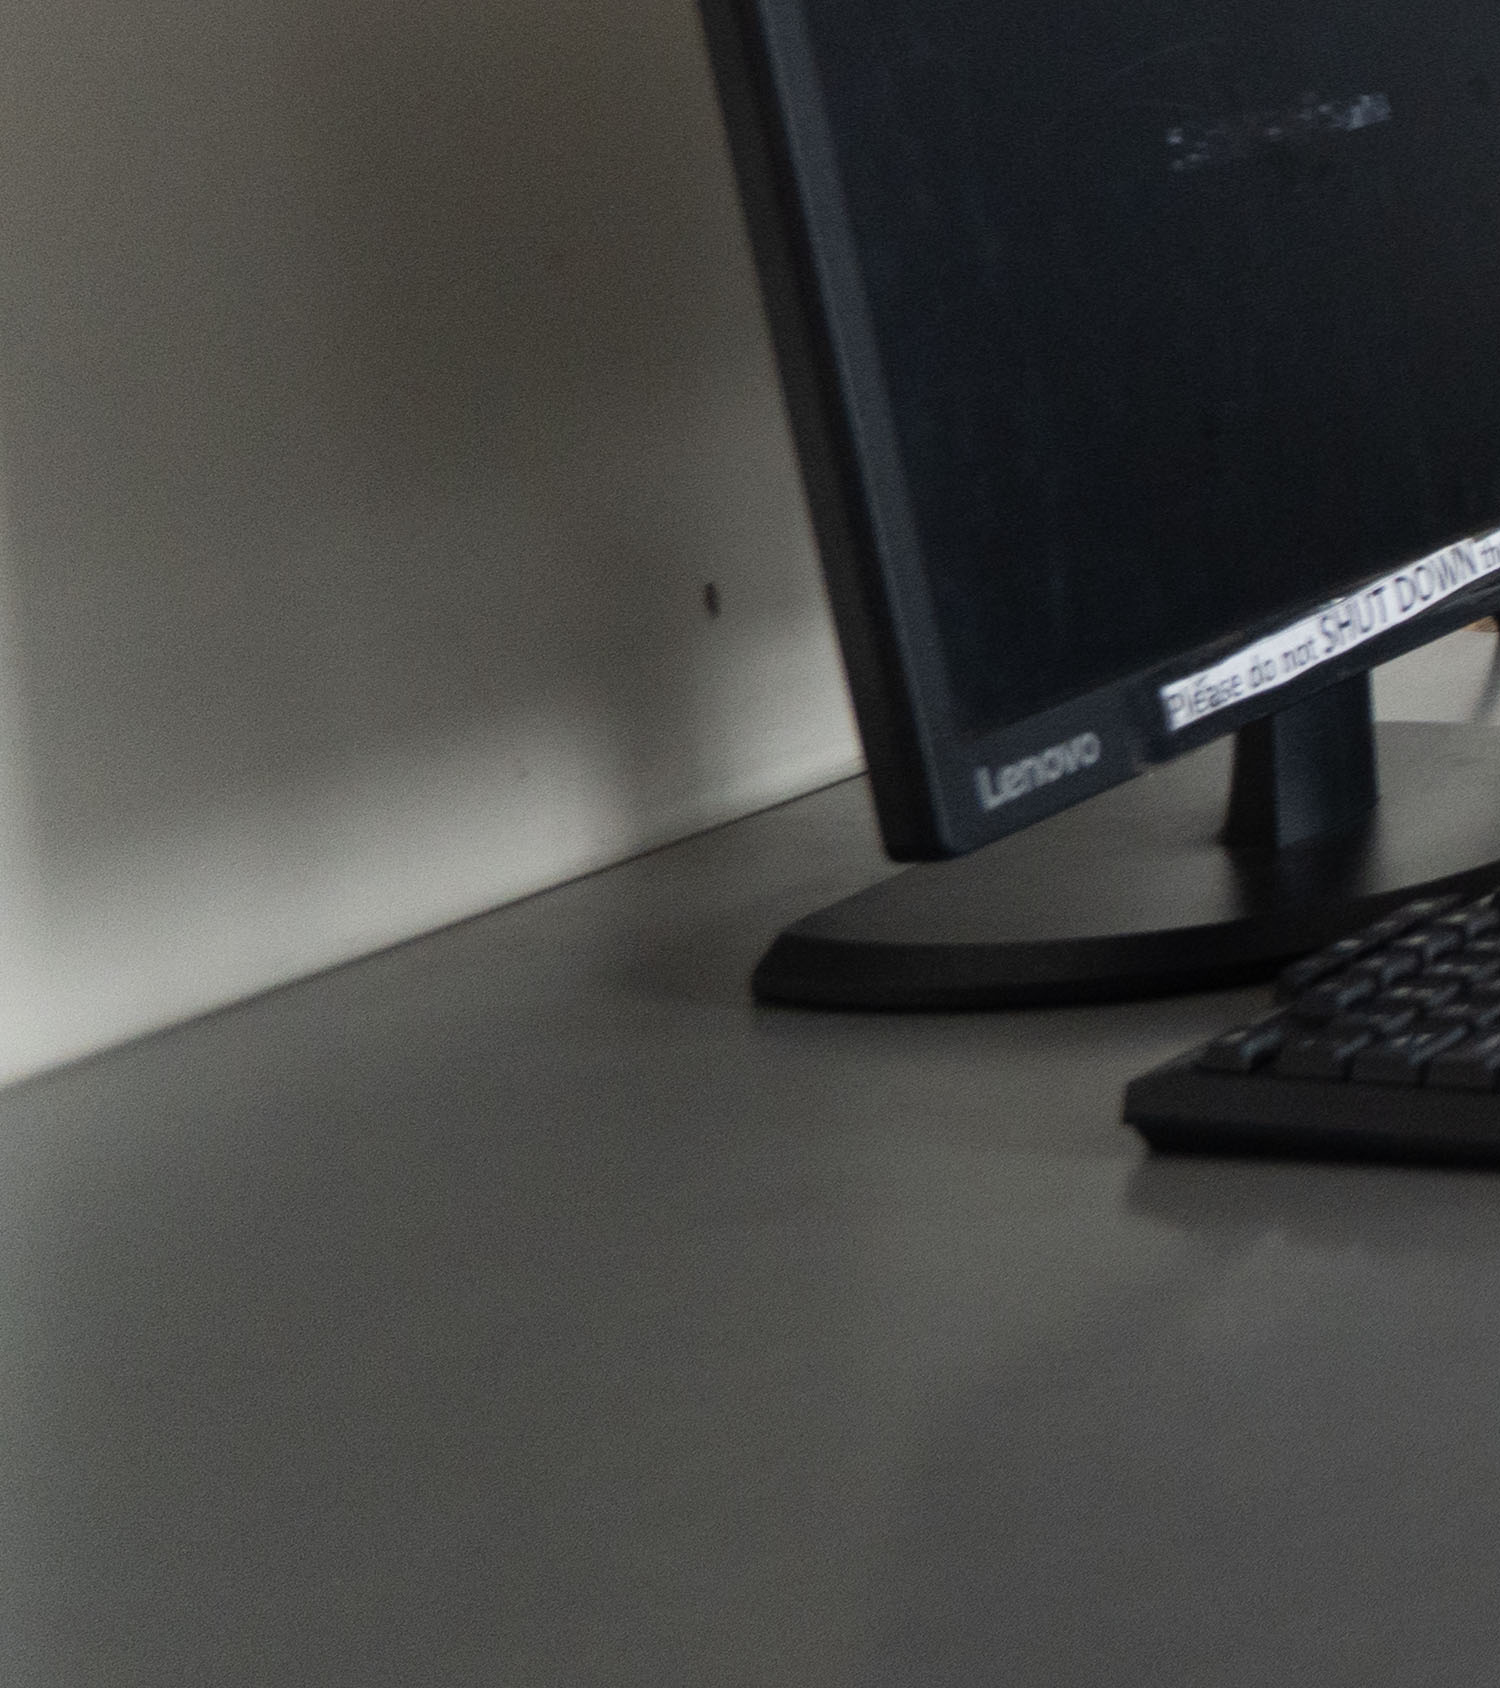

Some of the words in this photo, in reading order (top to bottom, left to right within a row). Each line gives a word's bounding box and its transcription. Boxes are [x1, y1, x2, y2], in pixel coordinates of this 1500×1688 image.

[1167, 674, 1244, 717] Please
[1249, 654, 1277, 689] do
[1282, 638, 1318, 673] not
[1320, 584, 1387, 653] SHUT
[1395, 543, 1478, 613] DOWN
[974, 730, 1101, 810] Lenovo
